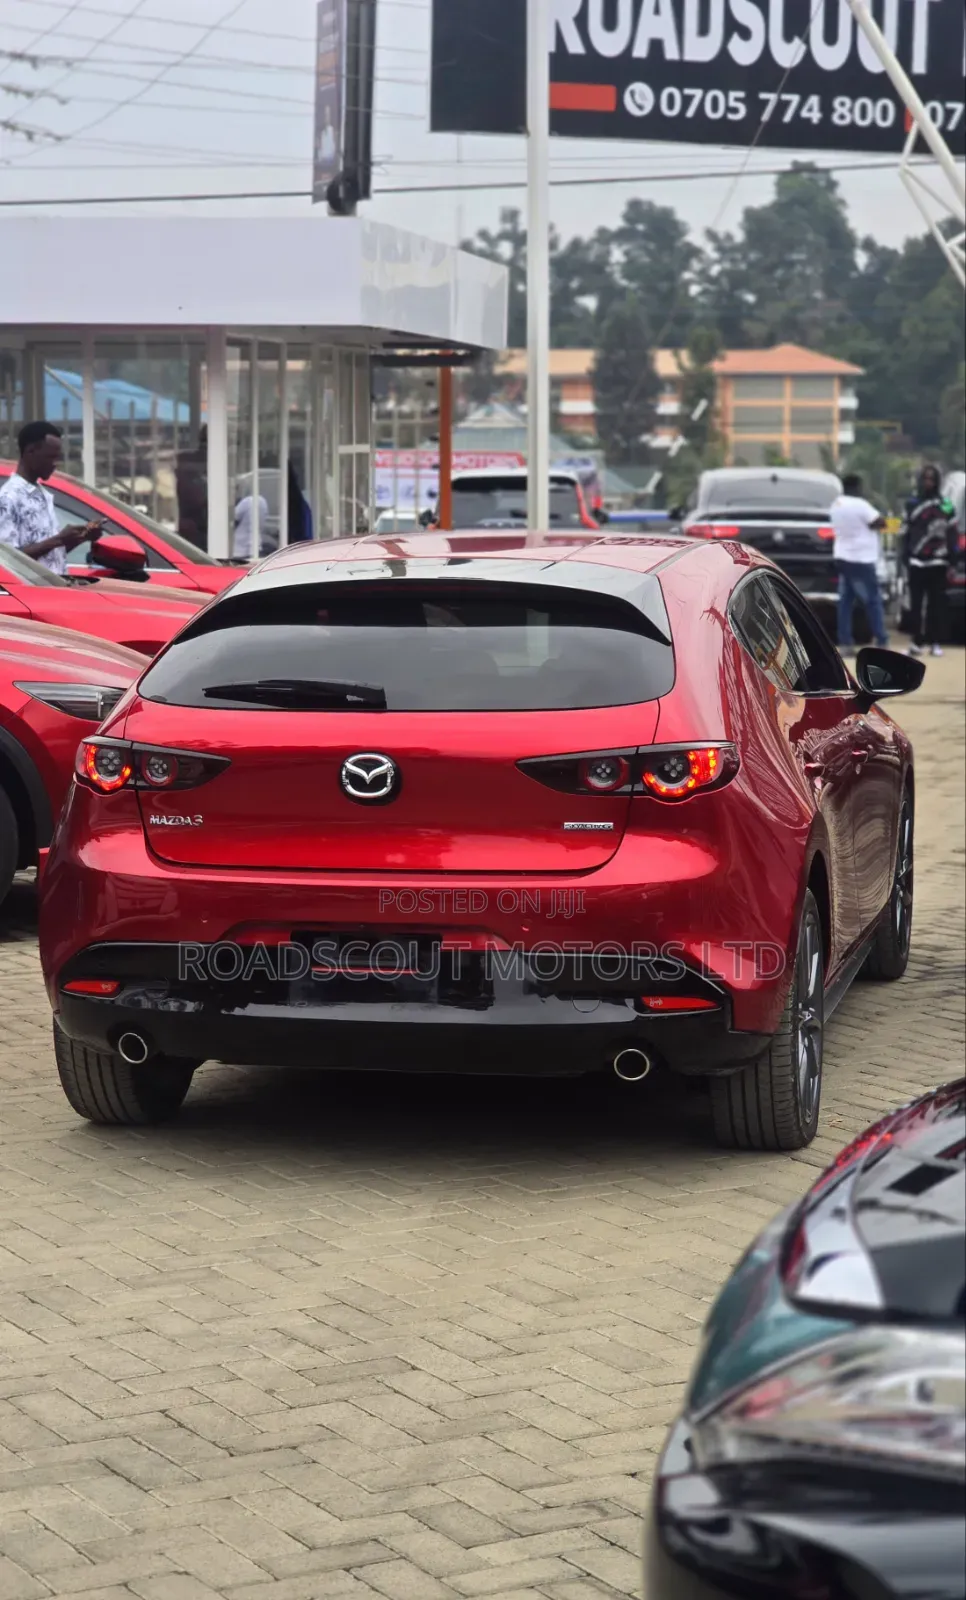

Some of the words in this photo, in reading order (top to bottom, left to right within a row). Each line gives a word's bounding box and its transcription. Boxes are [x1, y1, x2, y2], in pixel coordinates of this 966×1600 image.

[659, 86, 747, 121] 0705
[758, 92, 823, 125] 774
[831, 95, 896, 128] 800
[150, 814, 204, 826] MAZDA3
